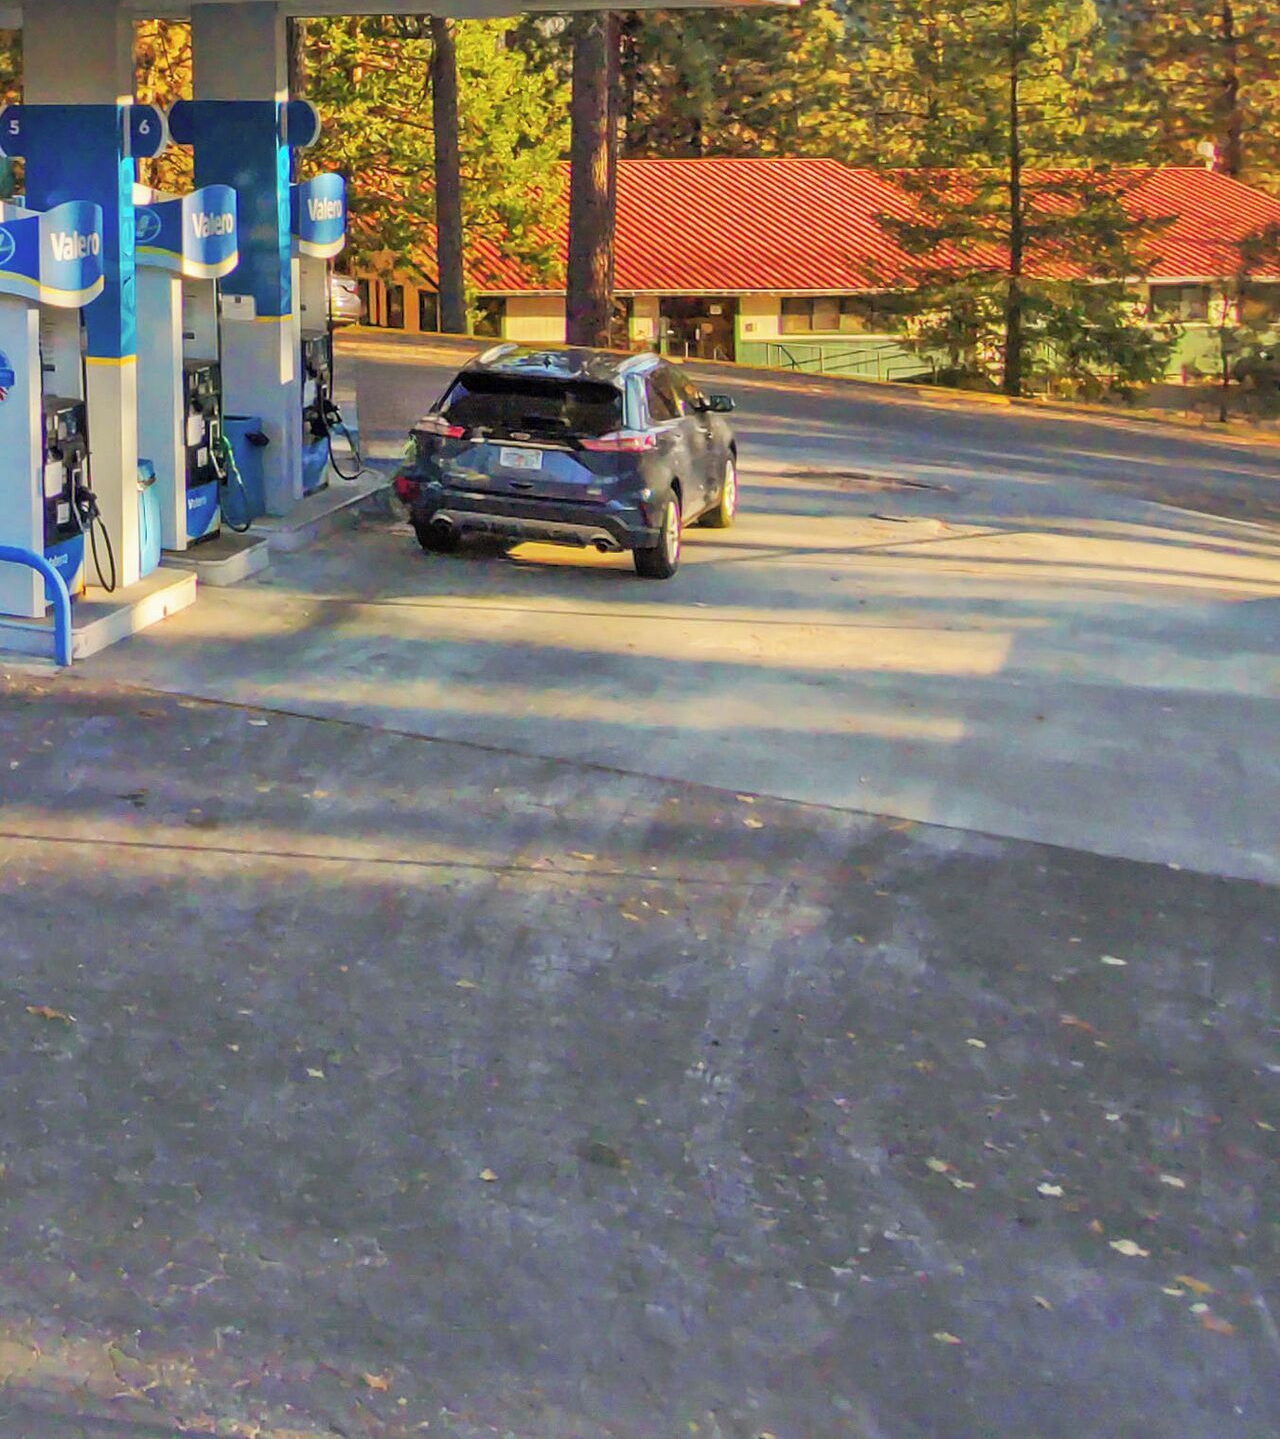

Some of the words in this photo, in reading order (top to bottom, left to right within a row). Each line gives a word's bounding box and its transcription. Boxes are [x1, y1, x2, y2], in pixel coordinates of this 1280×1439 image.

[8, 119, 20, 135] 5
[139, 119, 150, 134] 6
[307, 195, 343, 222] Valero
[192, 211, 234, 239] Valero
[50, 230, 100, 262] Valero
